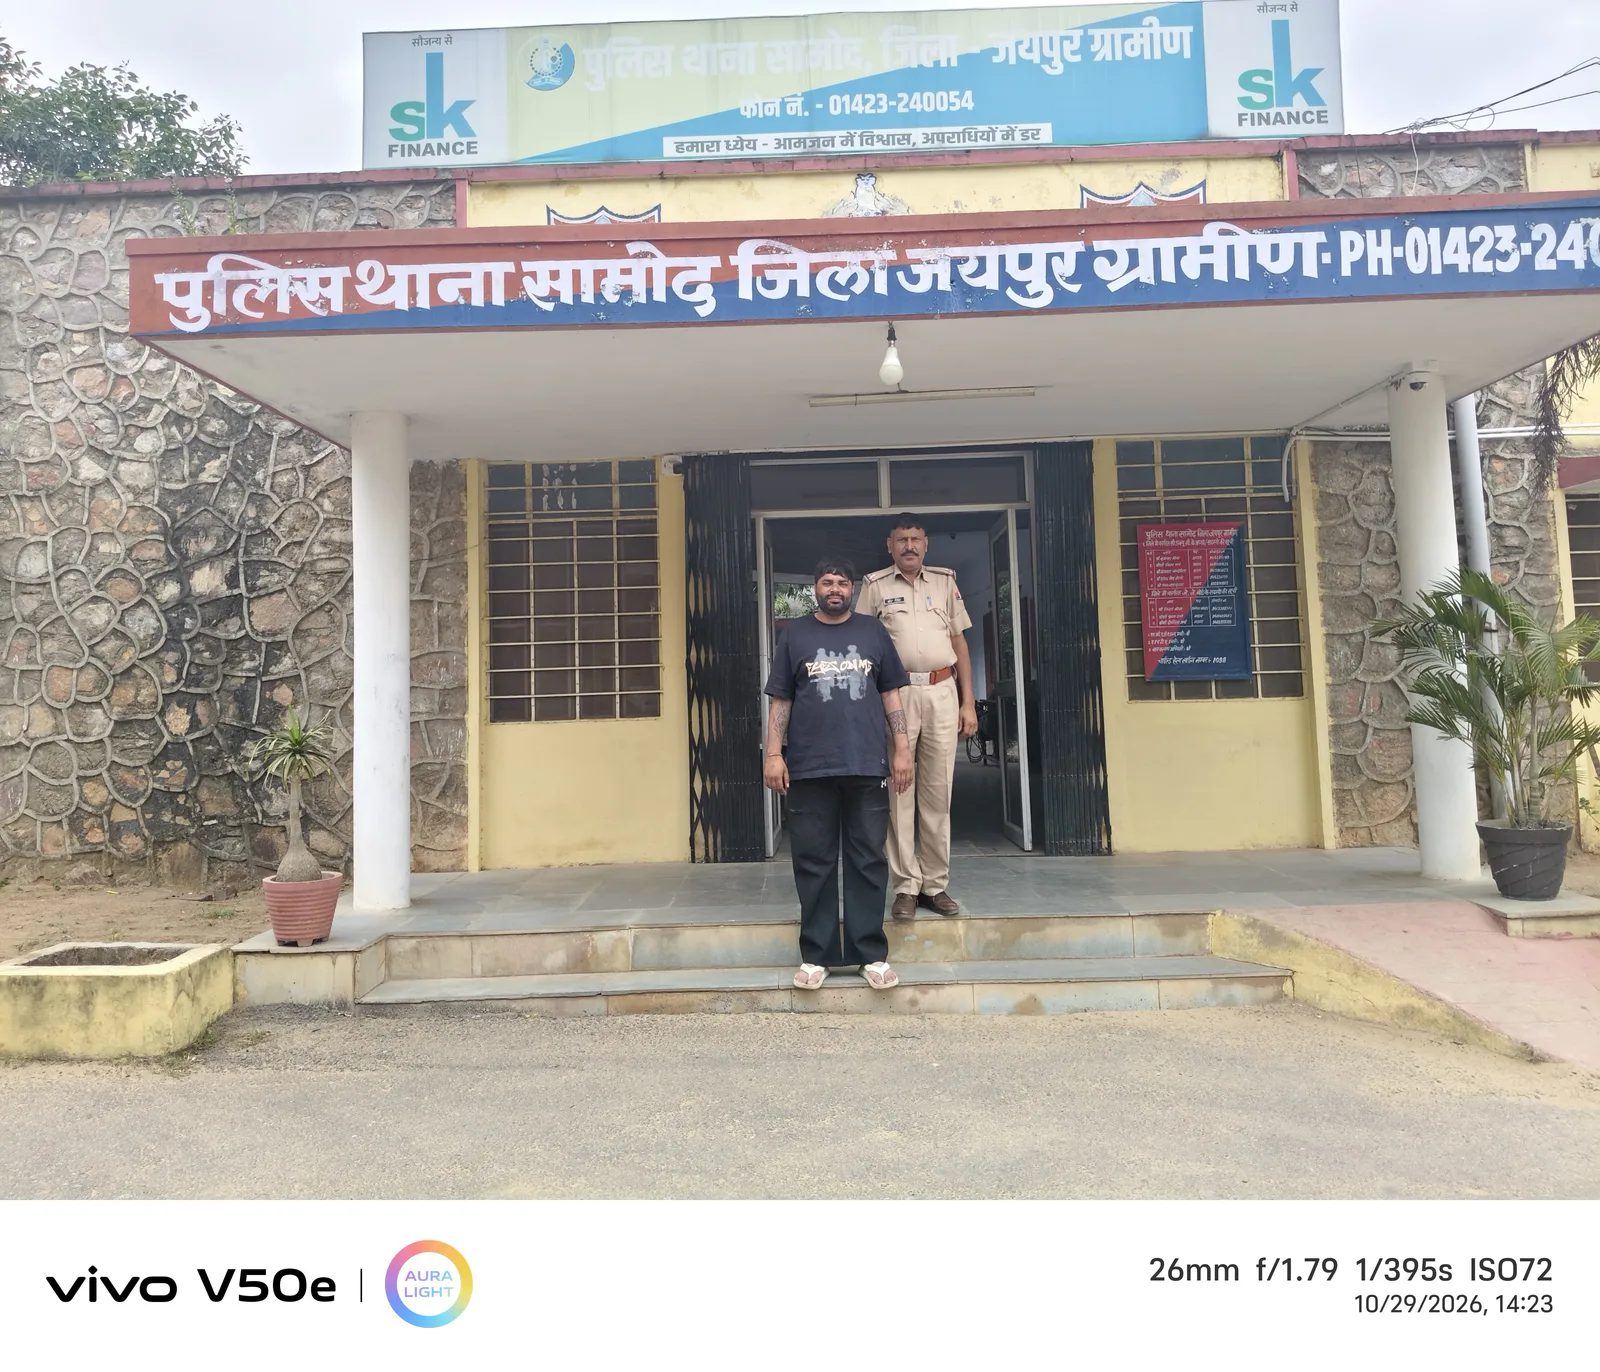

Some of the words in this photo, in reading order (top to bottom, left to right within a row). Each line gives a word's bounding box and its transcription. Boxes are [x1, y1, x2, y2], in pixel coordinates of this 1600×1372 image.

[1256, 2, 1287, 13] सौजन्य
[1289, 1, 1298, 12] से
[412, 35, 442, 47] सौजन्य
[444, 34, 453, 45] से
[582, 36, 674, 92] पुलिस
[682, 41, 757, 76] थाना
[879, 24, 962, 68] जिला
[988, 29, 1084, 75] जयपुर
[1088, 15, 1194, 62] ग्रामीण
[739, 92, 782, 119] फोन
[829, 90, 975, 116] 01423-240054
[1237, 110, 1329, 127] FINANCE
[388, 141, 479, 158] FINANCE
[674, 140, 722, 154] हमारा
[724, 136, 758, 151] ध्येय
[774, 135, 837, 150] आमजन
[839, 131, 857, 147] में
[858, 131, 917, 148] विश्वास,
[922, 127, 998, 144] अपराधियों
[1000, 126, 1018, 142] में
[1019, 128, 1042, 141] डर
[154, 252, 351, 332] पुलिस
[355, 259, 515, 311] थाना
[521, 240, 722, 318] सामोद
[729, 238, 897, 301] जिला
[897, 240, 1086, 308] जयपुर
